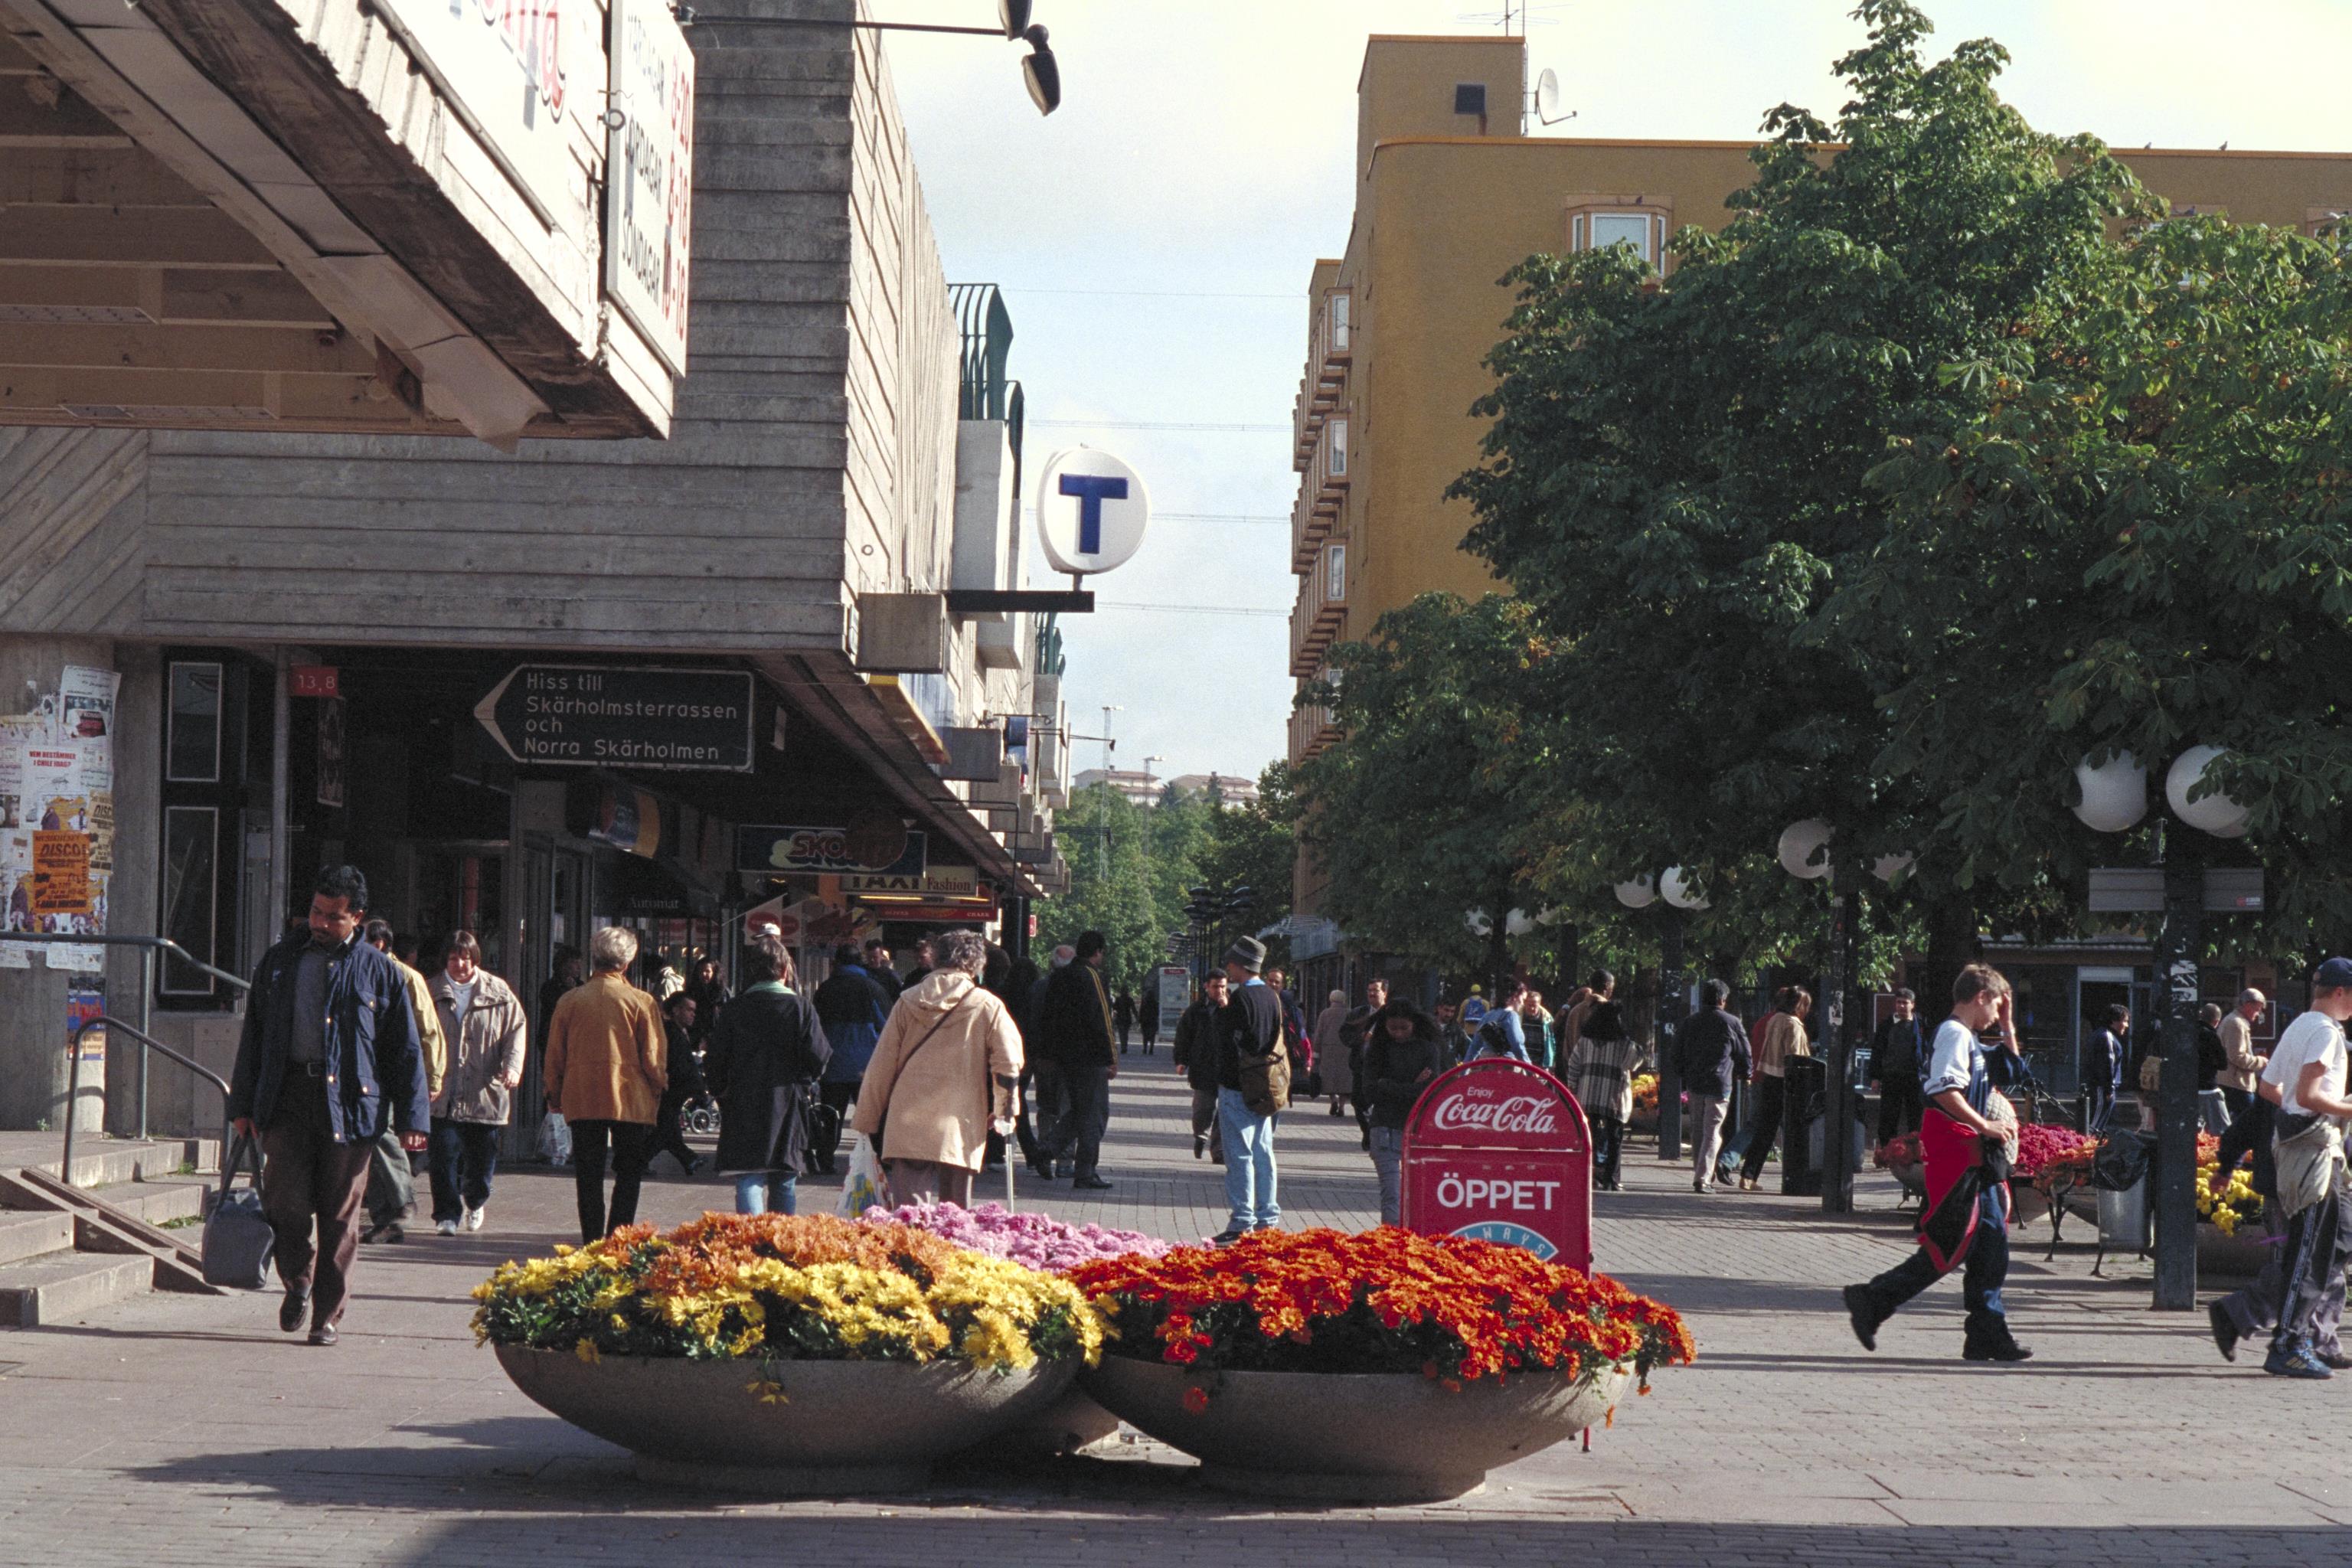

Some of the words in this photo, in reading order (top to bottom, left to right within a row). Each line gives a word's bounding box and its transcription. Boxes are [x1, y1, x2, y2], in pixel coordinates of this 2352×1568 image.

[671, 55, 691, 156] 8-20
[668, 150, 689, 250] 8-18
[622, 201, 661, 308] SÖNDAGAR
[662, 236, 686, 341] 10-18
[1059, 473, 1129, 554] T
[526, 672, 568, 690] Hiss
[577, 674, 602, 691] till
[526, 695, 737, 719] Skärholmsterrassen
[525, 717, 563, 733] och
[524, 737, 580, 755] Norra
[594, 738, 719, 760] Skärholmen
[41, 843, 81, 858] DISCO
[926, 877, 971, 892] Fashion
[1467, 1086, 1494, 1098] Enjoy
[1434, 1093, 1558, 1134] Coca-Cola
[1436, 1172, 1560, 1210] ÖPPET
